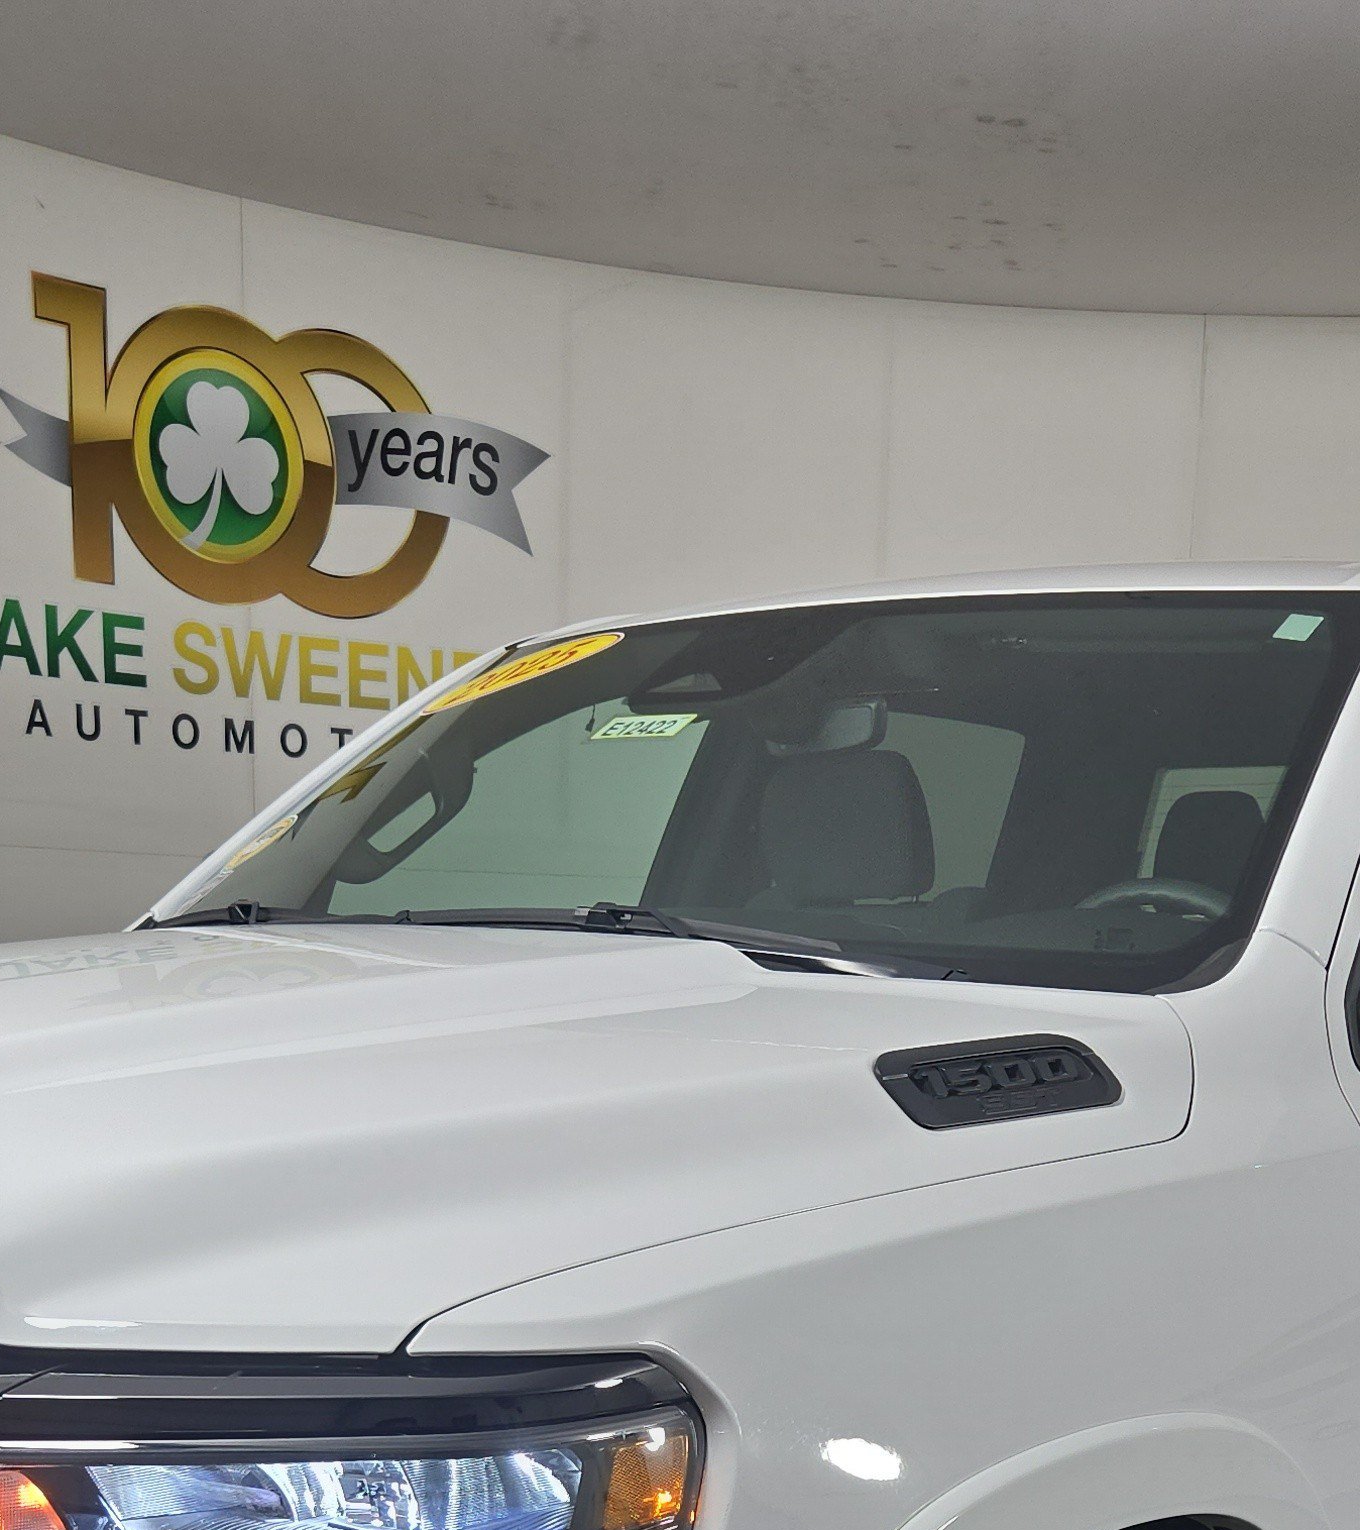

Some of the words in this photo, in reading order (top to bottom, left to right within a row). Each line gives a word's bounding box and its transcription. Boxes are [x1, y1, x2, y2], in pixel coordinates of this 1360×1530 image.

[31, 270, 451, 620] 100
[346, 426, 501, 496] years
[171, 620, 478, 712] SWEEN
[600, 719, 678, 737] E12422
[912, 1053, 1080, 1100] 1500
